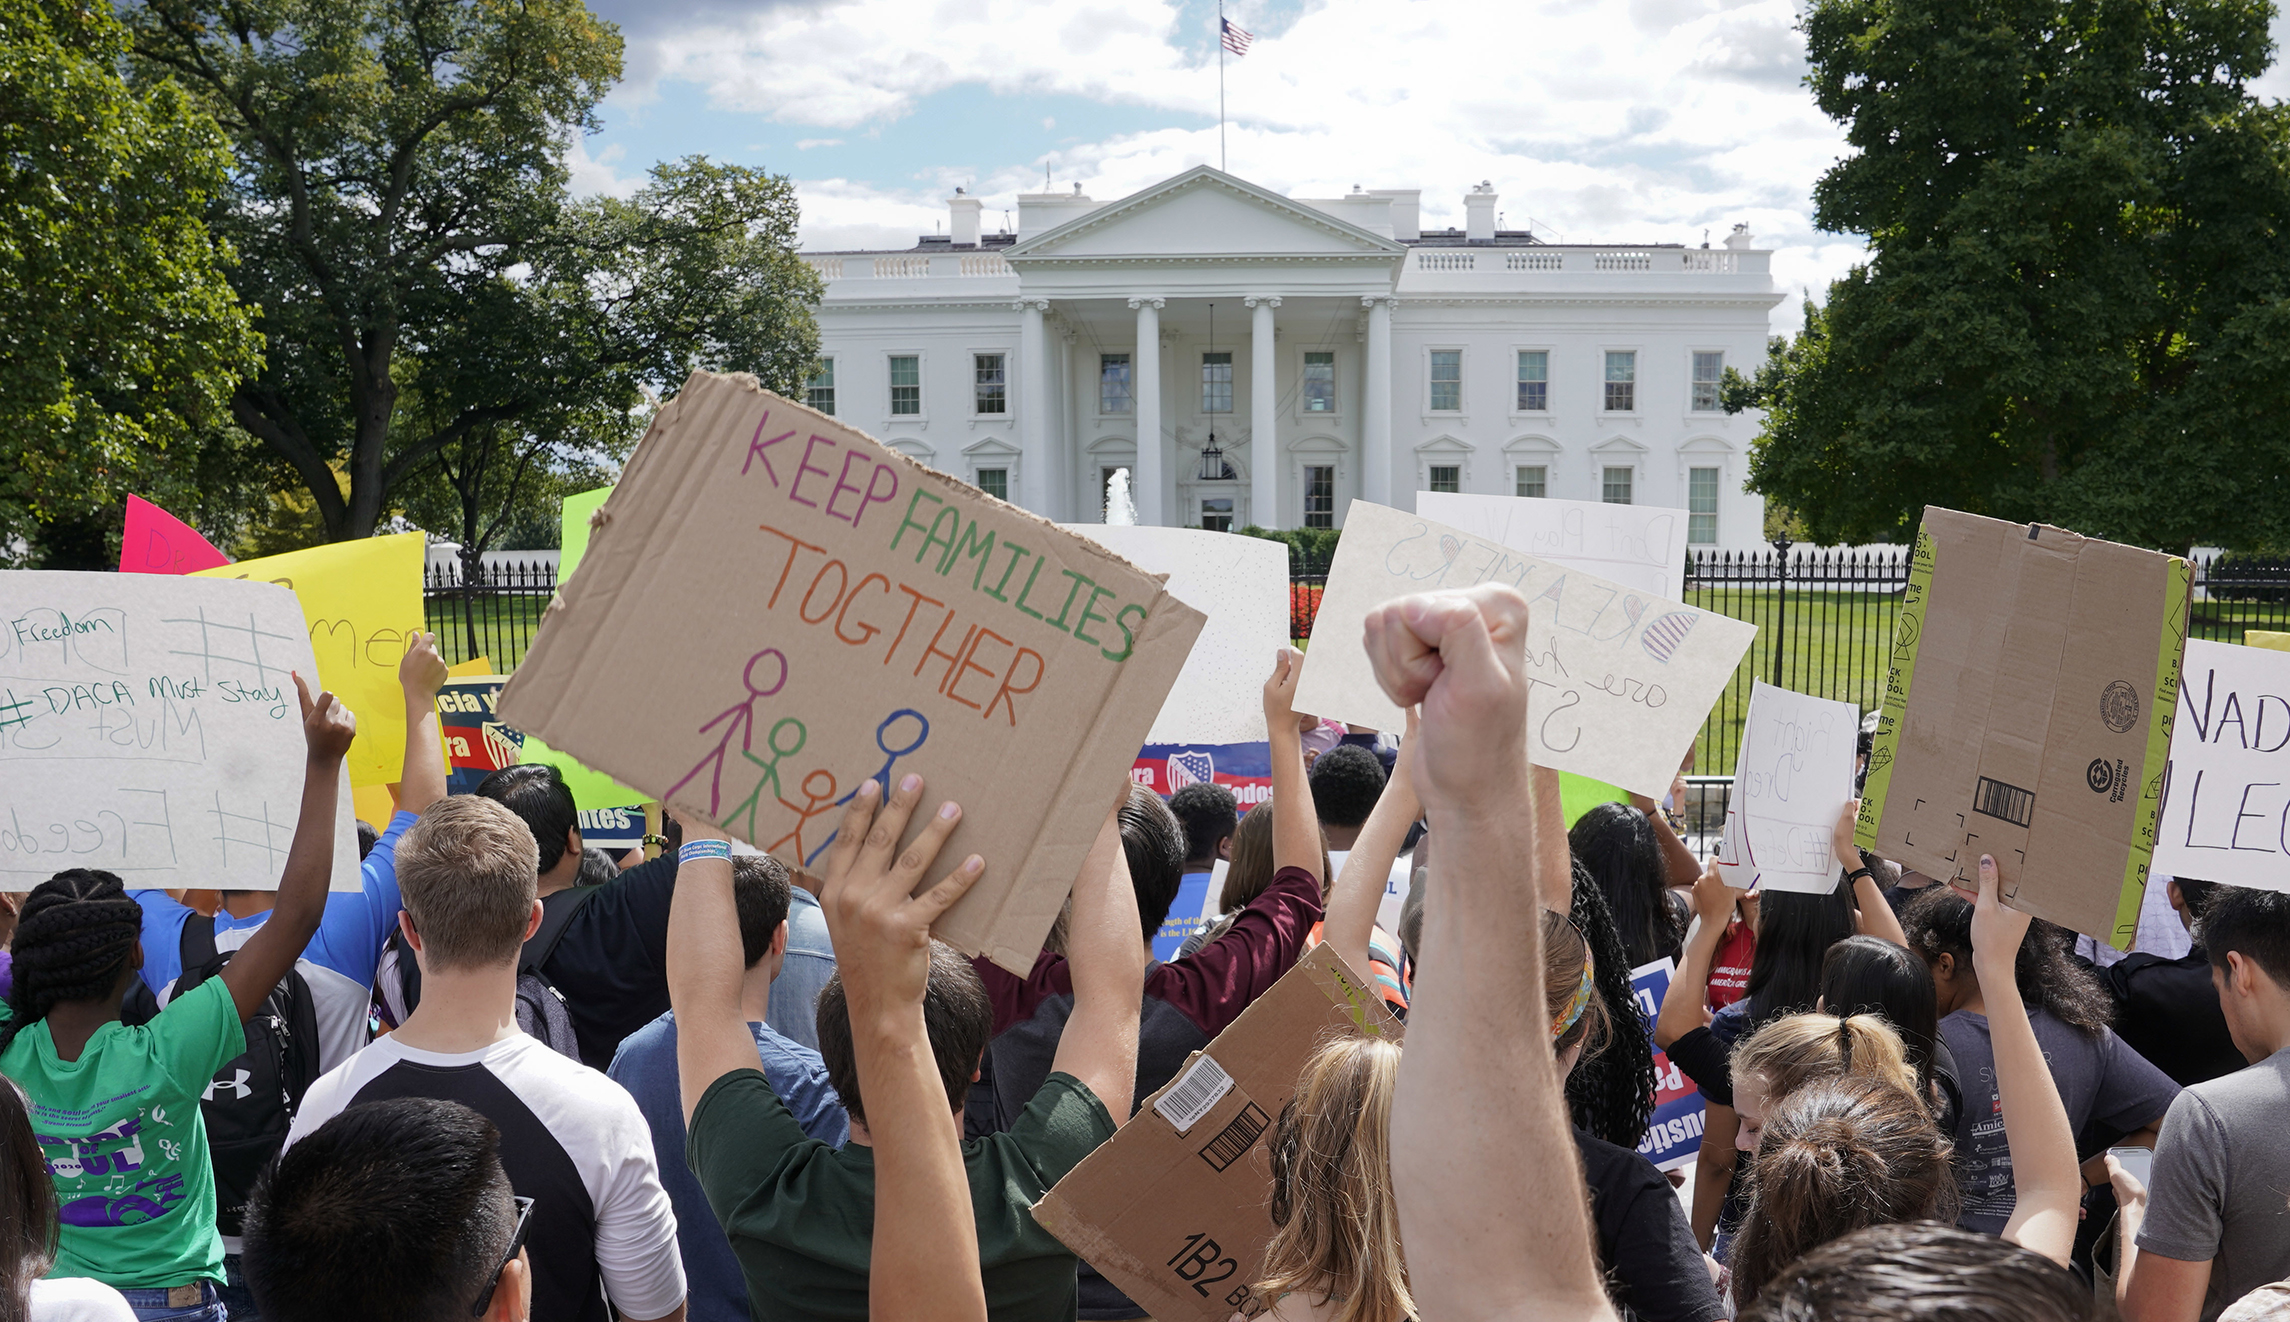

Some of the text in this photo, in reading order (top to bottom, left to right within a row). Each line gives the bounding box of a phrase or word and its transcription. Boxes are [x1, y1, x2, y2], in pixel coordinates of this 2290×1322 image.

[741, 410, 1147, 663] KEEP FAMILIES
[11, 610, 115, 646] Freedom
[759, 524, 1046, 727] TOGTHER
[217, 679, 289, 719] Stay
[2109, 758, 2124, 803] Corrugated
[2116, 765, 2130, 802] Recycles
[1858, 813, 1875, 825] OOL
[1166, 1232, 1238, 1298] 1B2
